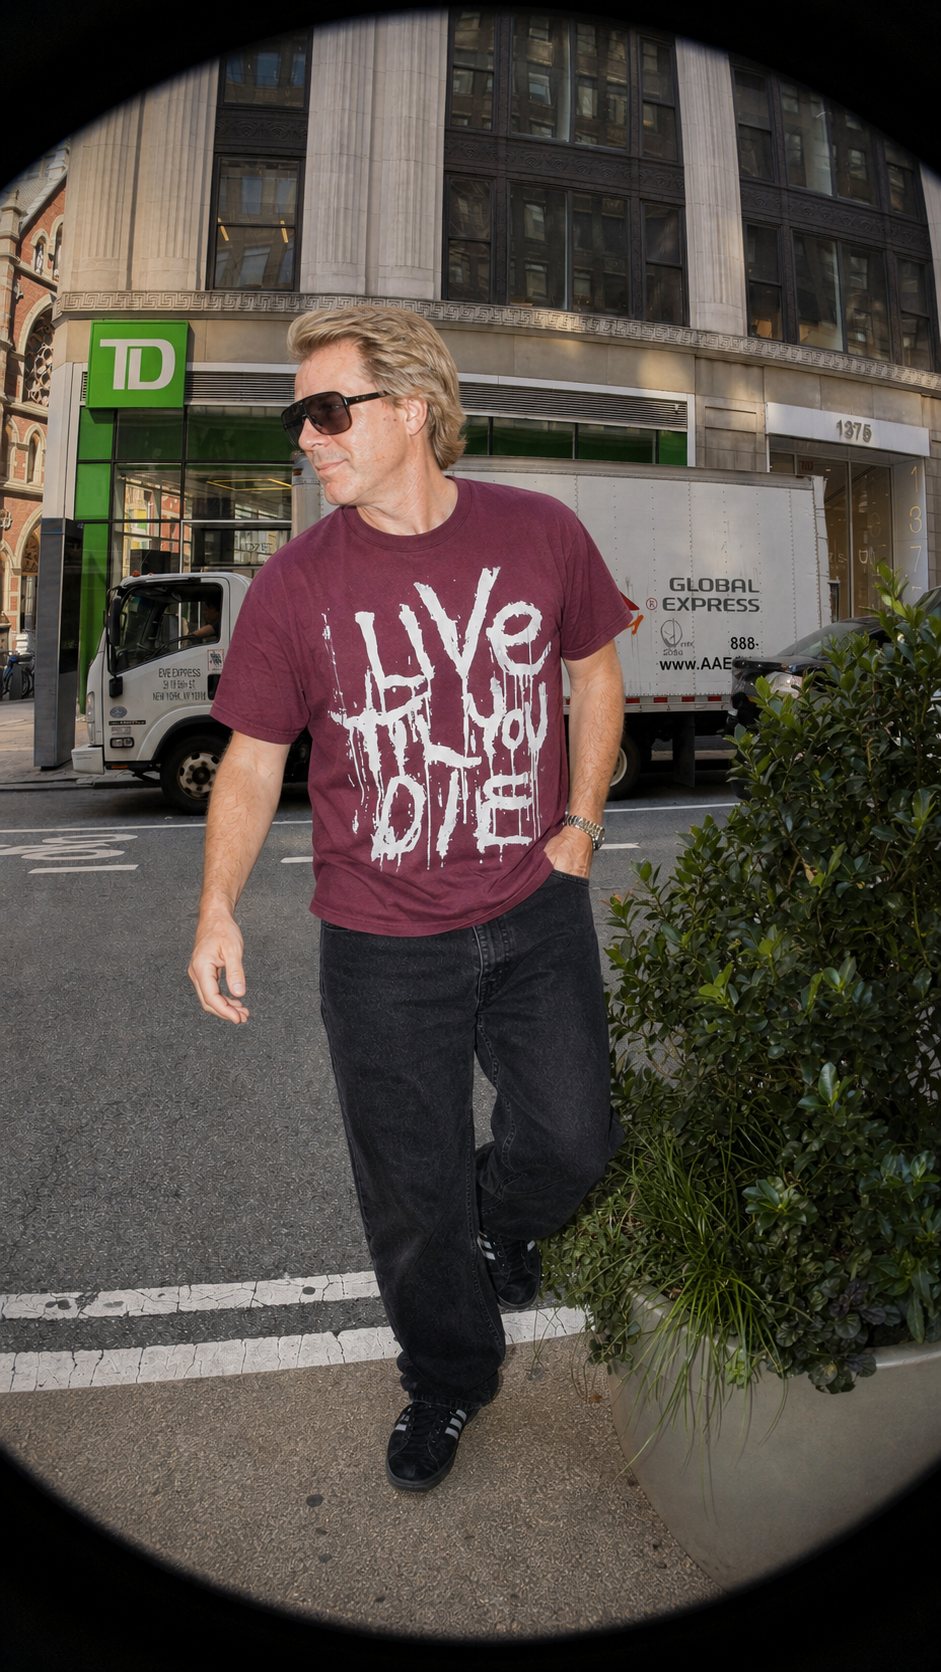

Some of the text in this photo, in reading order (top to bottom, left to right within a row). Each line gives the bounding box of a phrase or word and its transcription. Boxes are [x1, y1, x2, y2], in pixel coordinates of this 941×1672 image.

[99, 338, 176, 390] TD
[669, 577, 760, 593] GLOBAL
[662, 597, 760, 613] EXPRESS
[659, 656, 733, 671] www.AAE
[172, 668, 201, 678] EXPRESS
[371, 768, 534, 866] DIE
